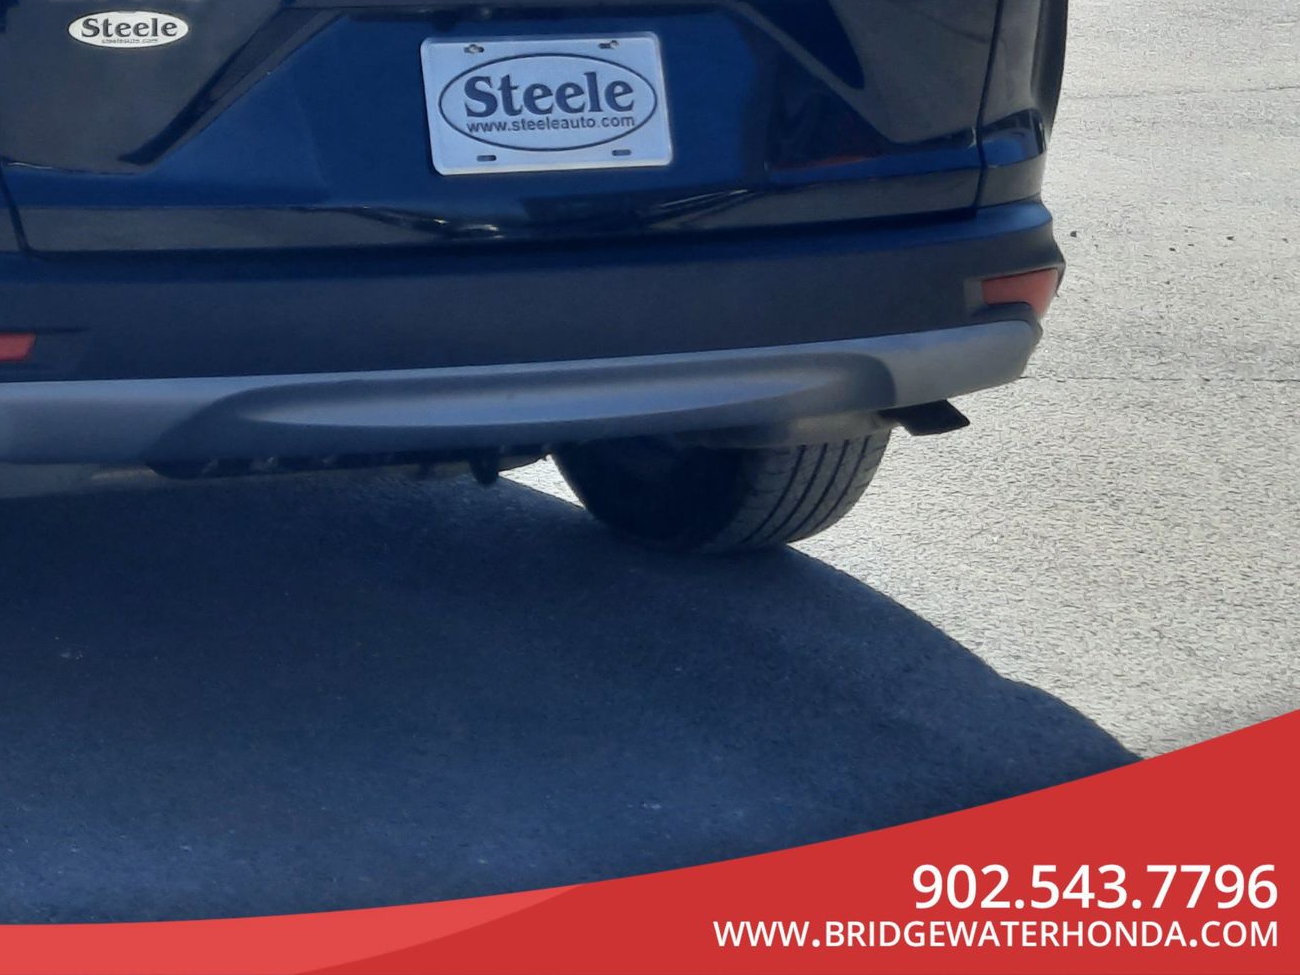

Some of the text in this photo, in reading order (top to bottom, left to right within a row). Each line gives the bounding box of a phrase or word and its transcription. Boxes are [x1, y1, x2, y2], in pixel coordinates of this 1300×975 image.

[81, 18, 178, 38] Steele
[464, 71, 635, 118] Steele
[466, 115, 635, 133] www.steeleauto.com
